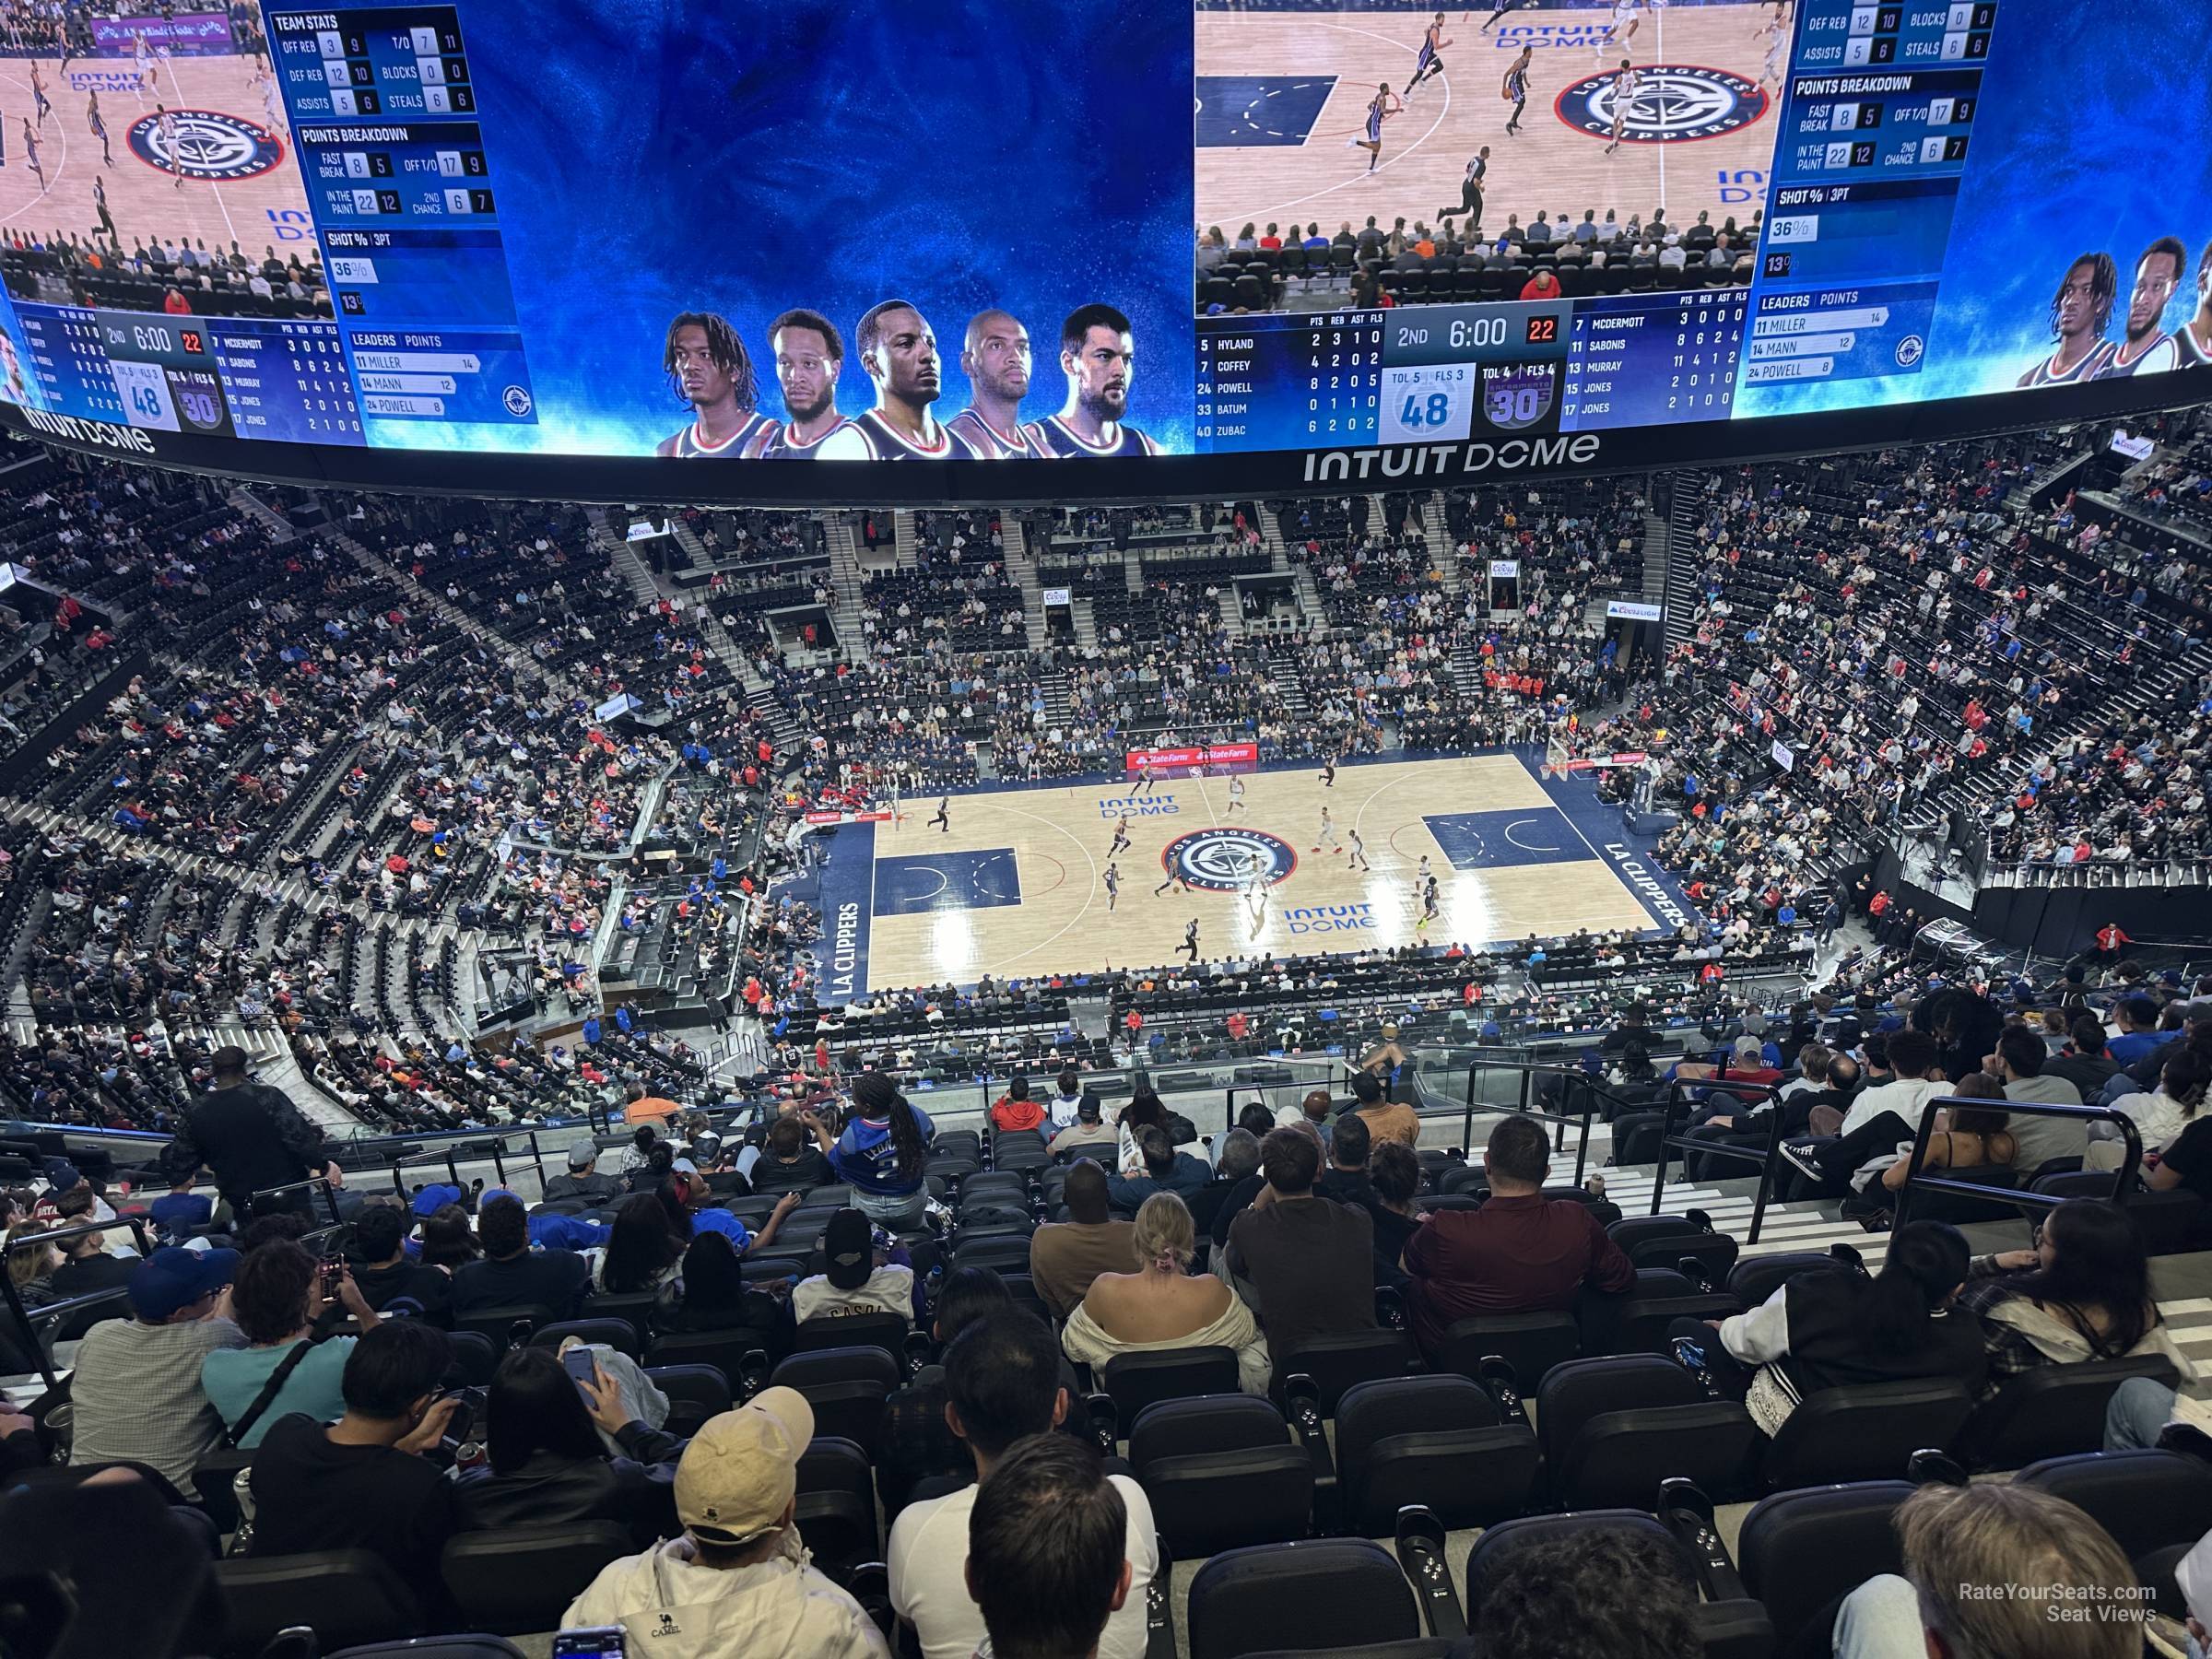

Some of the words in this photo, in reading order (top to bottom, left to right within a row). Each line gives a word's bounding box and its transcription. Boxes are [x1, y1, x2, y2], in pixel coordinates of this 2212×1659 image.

[276, 17, 305, 31] TEAM
[308, 15, 337, 29] STATS
[1809, 17, 1827, 29] DEF
[1829, 17, 1846, 29] REB
[1858, 15, 1869, 28] 12
[1884, 15, 1895, 28] 10
[1911, 13, 1946, 26] BLOCKS
[1956, 11, 1963, 24] 0
[1980, 10, 1987, 24] 0
[282, 41, 299, 53] OFF
[300, 40, 316, 53] REB
[392, 37, 409, 50] T/O
[1905, 42, 1939, 56] STEALS
[1949, 41, 1958, 53] 6
[1973, 39, 1982, 53] 6
[1804, 46, 1841, 59] ASSISTS
[1854, 46, 1862, 59] 5
[1879, 44, 1888, 57] 6
[289, 69, 306, 82] DEF
[307, 68, 323, 81] REB
[382, 66, 417, 79] BLOCKS
[1572, 74, 1613, 96] LOS
[1797, 79, 1838, 95] POINTS
[1840, 76, 1912, 93] BREAKDOWN
[297, 97, 330, 111] ASSISTS
[389, 95, 422, 108] STEALS
[1808, 105, 1830, 118] FAST
[1840, 111, 1849, 125] 8
[1865, 109, 1874, 125] 5
[1895, 109, 1912, 122] OFF
[1912, 107, 1928, 120] T/O
[1936, 105, 1947, 120] 17
[1959, 103, 1969, 120] 9
[1800, 120, 1827, 133] BREAK
[302, 129, 340, 142] POINTS
[341, 127, 409, 142] BREAKDOWN
[1797, 146, 1807, 157] IN
[1809, 144, 1824, 156] THE
[1900, 142, 1916, 153] 2ND
[1928, 144, 1936, 159] 6
[1954, 142, 1961, 157] 7
[1829, 149, 1845, 164] 22
[1856, 147, 1869, 162] 12
[1885, 153, 1913, 166] CHANCE
[1797, 159, 1822, 171] PAINT
[1780, 191, 1806, 205] SHOT
[1809, 189, 1823, 203] %
[1830, 188, 1849, 202] 3PT
[328, 234, 352, 245] SHOT
[374, 234, 391, 245] 3PT
[1700, 295, 1712, 303] REB
[1718, 293, 1731, 302] AST
[1762, 295, 1810, 310] LEADERS
[1819, 291, 1858, 305] POINTS
[1311, 317, 1324, 326] PTS
[1331, 316, 1345, 324] REB
[1351, 315, 1364, 324] AST
[1370, 313, 1382, 323] FLS
[1576, 320, 1583, 332] 7
[1593, 317, 1644, 330] MCDERMOTT
[1757, 322, 1767, 334] 11
[1770, 319, 1806, 332] MILLER
[1871, 313, 1880, 323] 14
[107, 326, 125, 343] 2ND
[134, 326, 171, 352] 6:00
[182, 334, 201, 351] 22
[1397, 327, 1429, 347] 2ND
[1450, 318, 1508, 347] 6:00
[1529, 320, 1554, 339] 22
[353, 335, 396, 346] LEADERS
[406, 335, 442, 347] POINTS
[1200, 339, 1208, 352] 5
[1218, 339, 1253, 350] HYLAND
[1572, 341, 1582, 352] 11
[1589, 339, 1626, 351] SABONIS
[1753, 345, 1763, 355] 14
[1766, 341, 1797, 354] MANN
[1840, 337, 1849, 348] 12
[369, 357, 402, 369] MILLER
[1201, 361, 1208, 372] 7
[1218, 361, 1250, 372] COFFEY
[1569, 363, 1582, 374] 13
[1587, 361, 1622, 372] MURRAY
[1748, 369, 1759, 378] 24
[1762, 364, 1801, 378] POWELL
[1822, 361, 1829, 372] 8
[1393, 372, 1408, 383] TOL
[1414, 372, 1420, 382] 5
[1435, 371, 1453, 382] FLS
[1456, 370, 1464, 380] 3
[1483, 369, 1499, 380] TOL
[1503, 367, 1512, 378] 4
[1527, 365, 1545, 376] FLS
[1547, 363, 1556, 376] 4
[374, 378, 402, 390] MANN
[1197, 383, 1211, 394] 24
[1218, 383, 1253, 394] POWELL
[1567, 383, 1578, 394] 15
[1583, 382, 1611, 393] JONES
[132, 386, 161, 415] 48
[380, 400, 415, 413] POWELL
[1491, 389, 1538, 422] 30
[182, 393, 216, 422] 30
[1197, 405, 1211, 415] 33
[1217, 404, 1246, 415] BATUM
[1401, 393, 1449, 427] 48
[1564, 405, 1576, 415] 17
[1582, 403, 1609, 415] JONES
[1196, 426, 1211, 437] 40
[1217, 426, 1246, 436] ZUBAC
[1201, 830, 1281, 848] ANGELES
[1187, 870, 1285, 889] CLIPRS
[1605, 843, 1631, 861] LA
[1622, 862, 1688, 927] CLIPPERS
[834, 903, 859, 971] CLIPPERS
[831, 973, 853, 995] LA
[37, 1206, 60, 1217] BRYA
[651, 1625, 682, 1637] CAMEL
